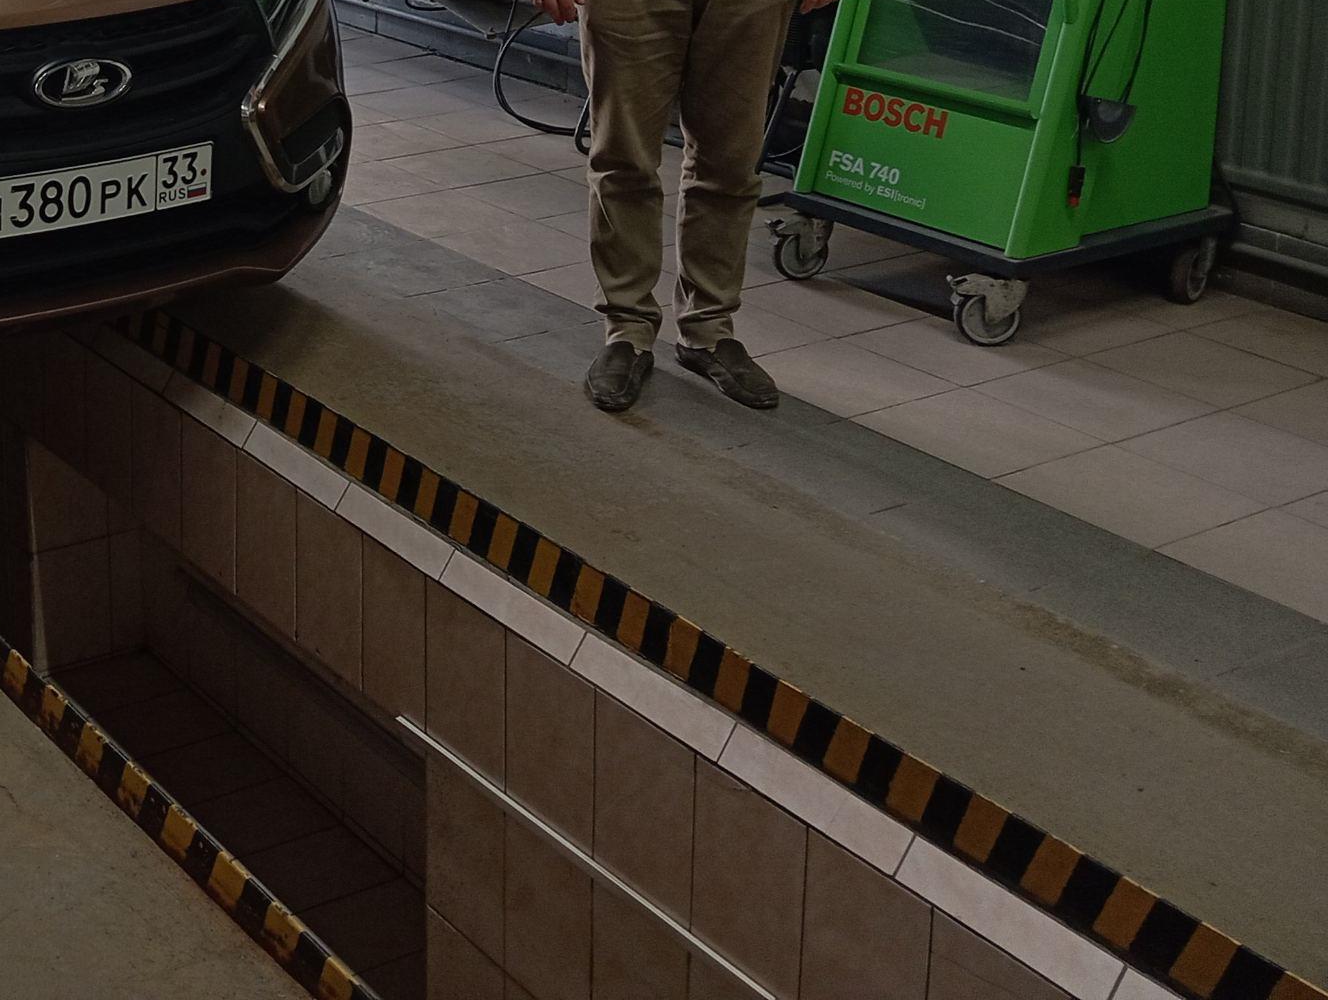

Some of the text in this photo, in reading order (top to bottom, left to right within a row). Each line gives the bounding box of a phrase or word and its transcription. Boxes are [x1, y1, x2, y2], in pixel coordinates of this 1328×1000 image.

[842, 87, 949, 139] BOSCH
[161, 151, 198, 189] 33
[829, 150, 900, 185] FSA 740
[159, 188, 186, 204] RUS
[864, 181, 876, 196] by
